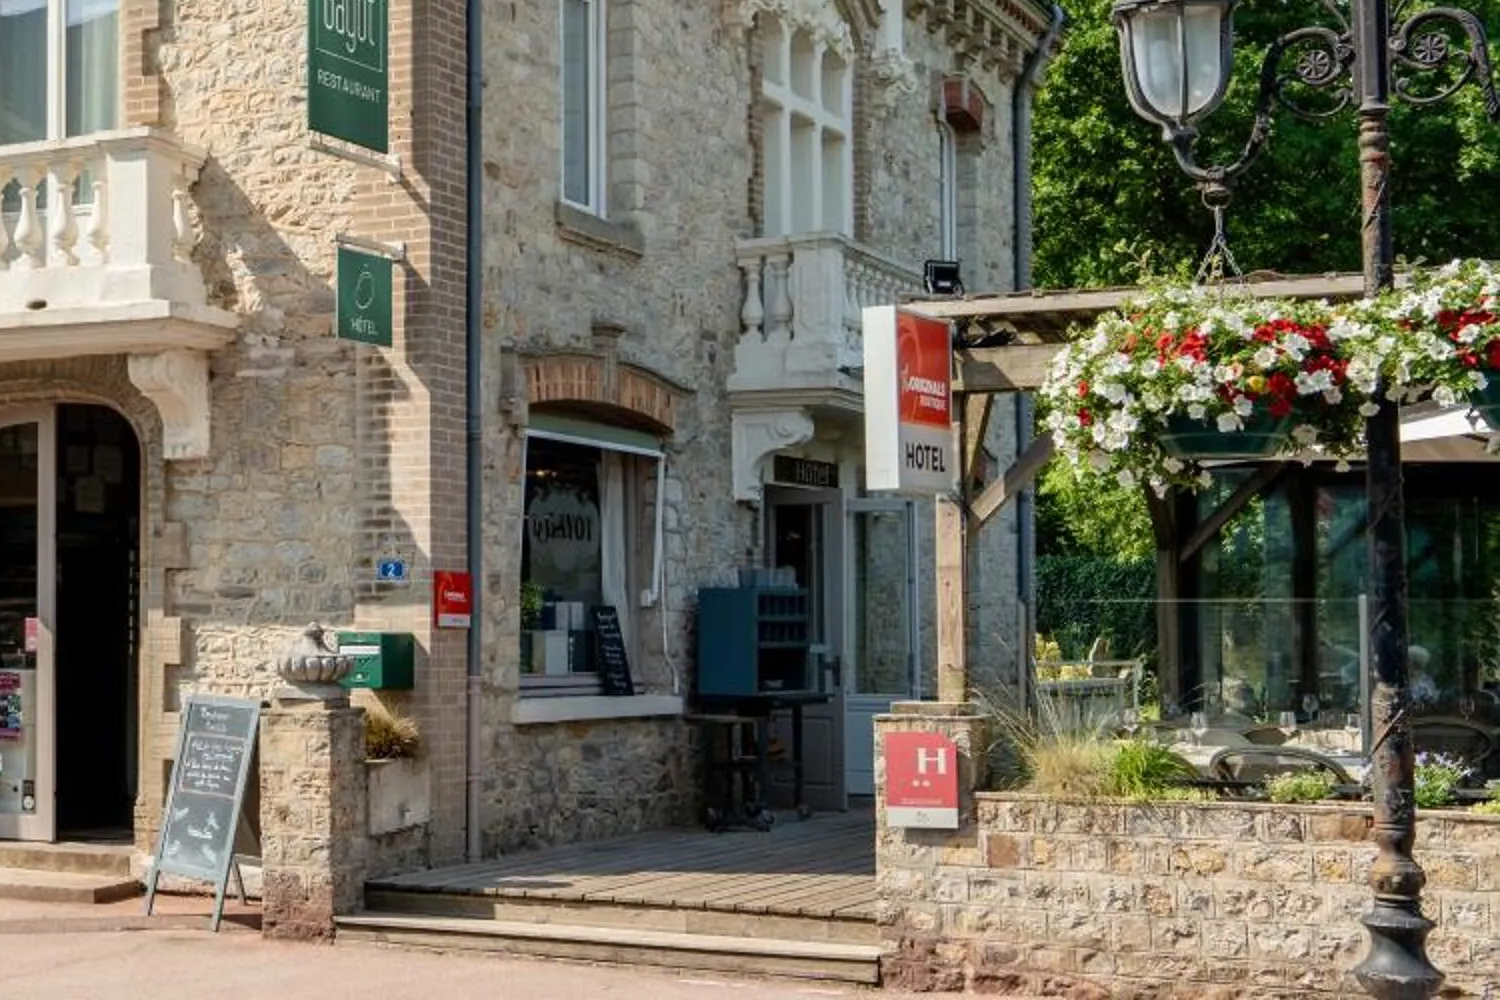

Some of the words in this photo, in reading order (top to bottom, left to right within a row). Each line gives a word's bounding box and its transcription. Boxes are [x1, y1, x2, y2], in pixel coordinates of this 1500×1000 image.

[317, 69, 381, 103] RESTAURANT
[387, 563, 395, 577] 2
[917, 746, 947, 775] H
